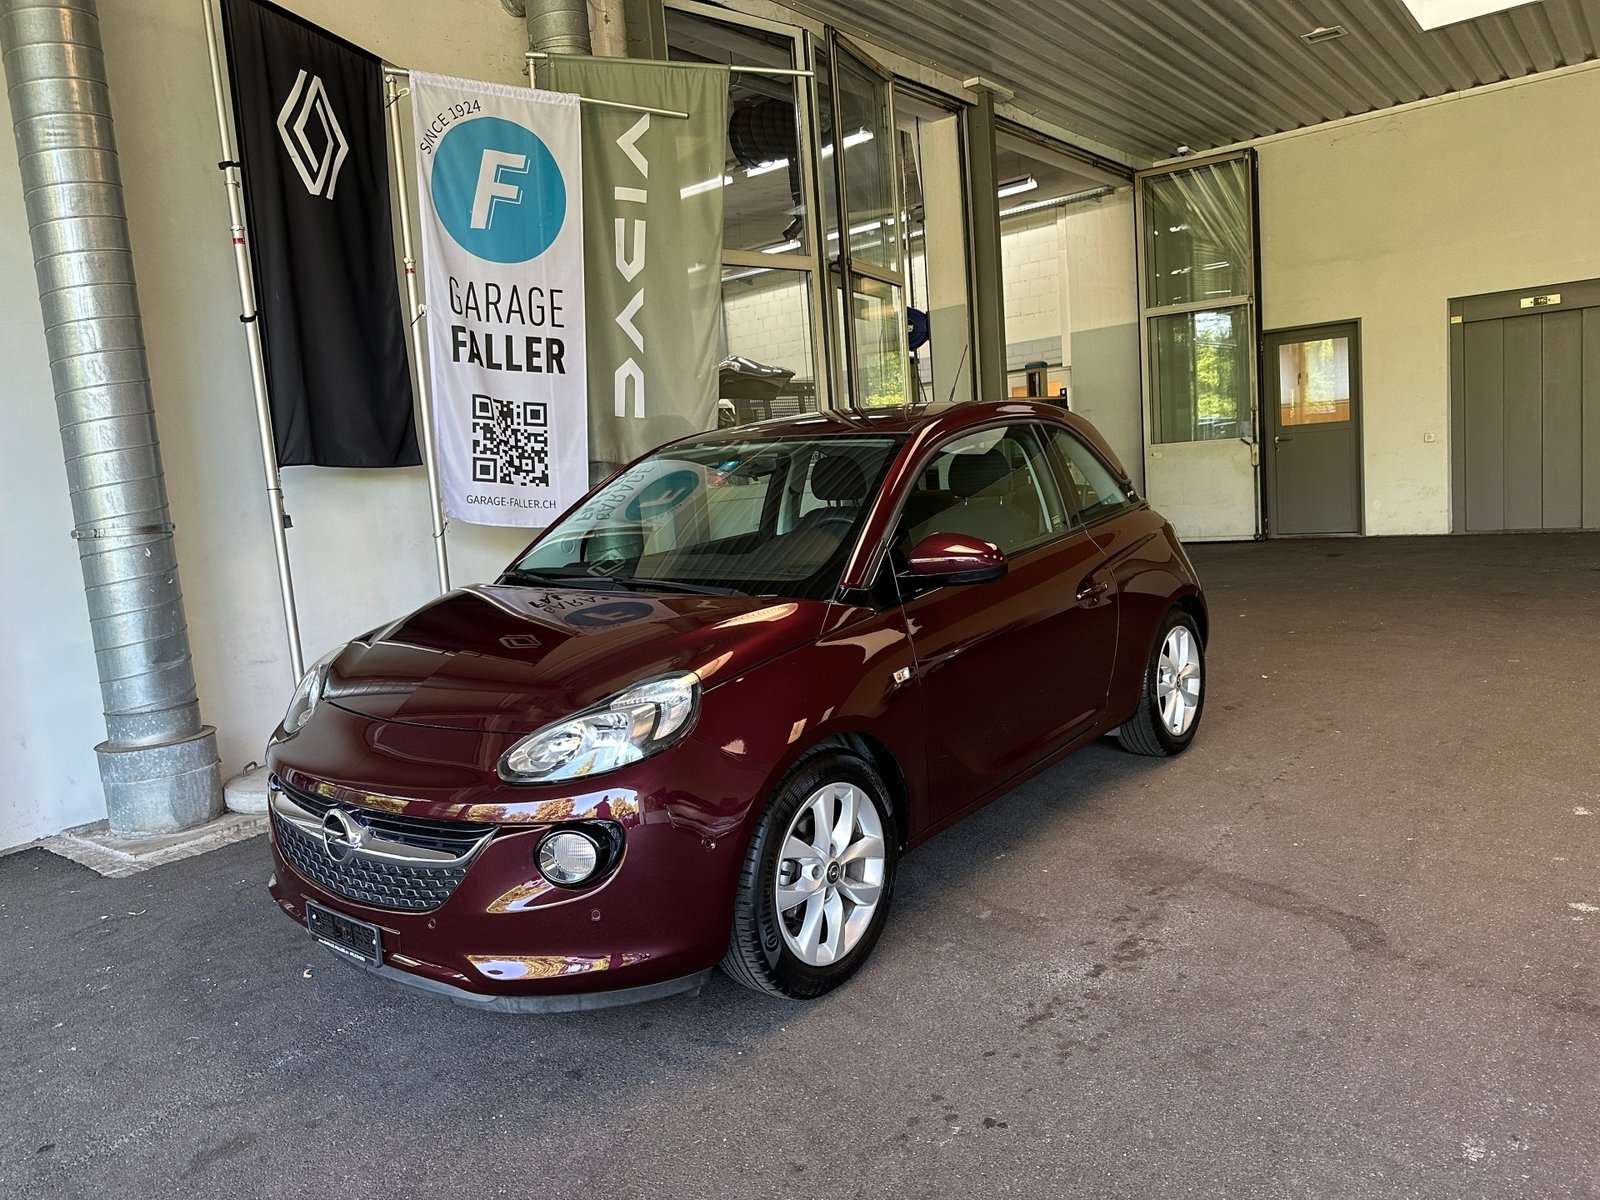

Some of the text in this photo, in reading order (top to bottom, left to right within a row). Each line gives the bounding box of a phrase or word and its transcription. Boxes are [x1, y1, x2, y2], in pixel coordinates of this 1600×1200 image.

[420, 99, 482, 155] SINCE 1924
[470, 148, 531, 230] F
[614, 112, 650, 419] DACIA
[449, 276, 565, 328] GARAGE
[451, 324, 566, 375] FALLER
[466, 494, 557, 509] GARAGE-FALLER.CH
